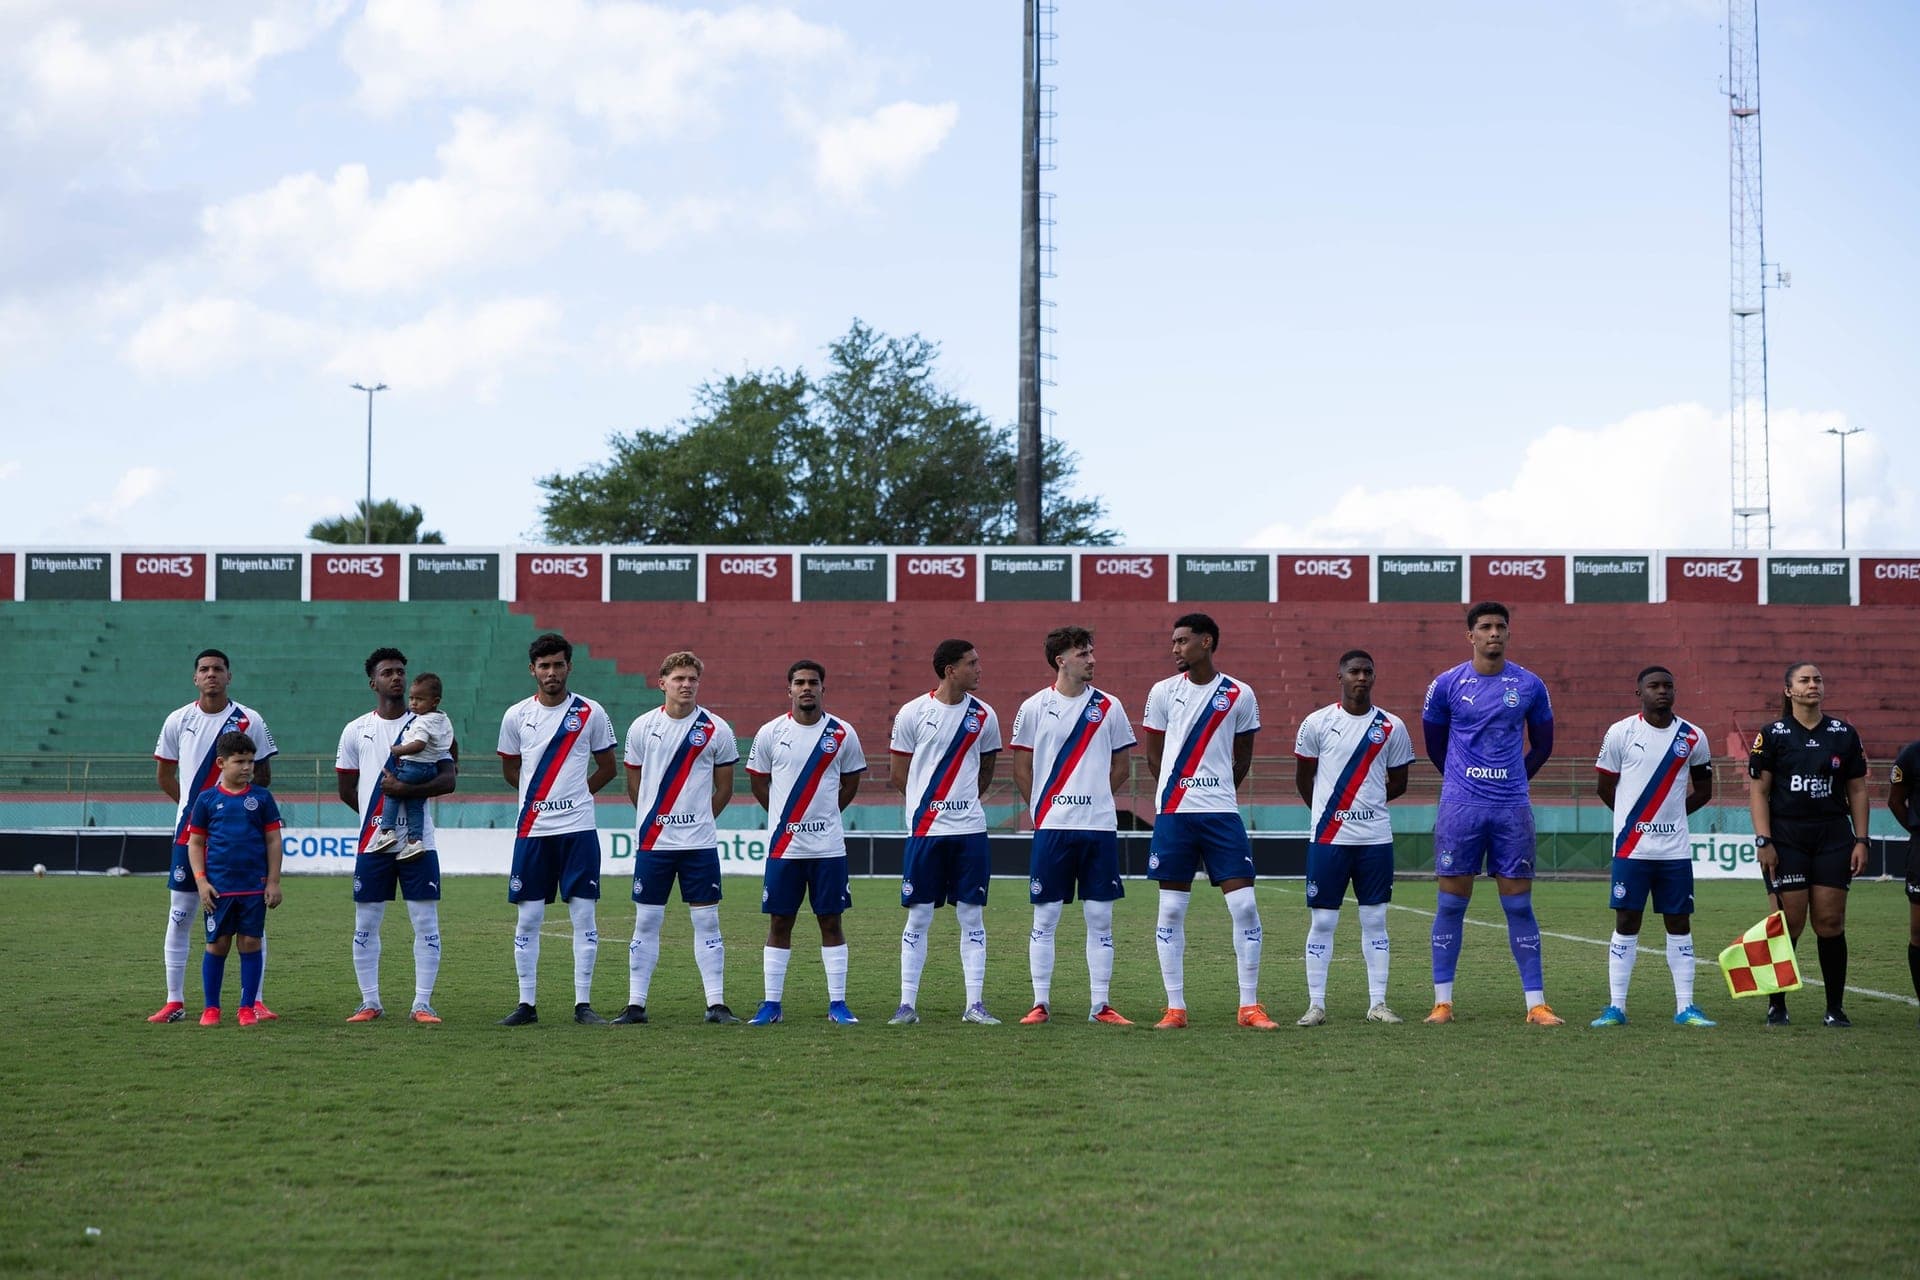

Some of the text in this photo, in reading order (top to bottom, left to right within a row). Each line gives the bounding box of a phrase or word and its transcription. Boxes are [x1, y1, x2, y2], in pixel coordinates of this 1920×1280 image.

[32, 558, 102, 572] Dirigente.NET
[136, 558, 192, 577] CORE3
[222, 558, 294, 572] Dirigente.NET
[327, 558, 383, 577] CORE3
[418, 559, 486, 573] Dirigente.NET
[531, 558, 588, 577] CORE3
[618, 559, 691, 574] Dirigente.NET
[721, 558, 777, 577] CORE3
[807, 559, 875, 573] Dirigente.NET
[908, 558, 965, 577] CORE3
[992, 560, 1064, 573] Dirigente.NET
[1096, 558, 1153, 578] CORE3
[1186, 560, 1256, 574] Dirigente.NET
[1295, 559, 1351, 579] CORE3
[1383, 561, 1456, 575] Dirigente.NET
[1489, 560, 1546, 579] CORE3
[1576, 562, 1644, 575] Dirigente.NET
[1684, 560, 1742, 582] CORE3
[1772, 563, 1844, 577] Dirigente.NET
[1875, 564, 1920, 579] CORE
[1466, 767, 1508, 779] FOXLUX
[1180, 777, 1220, 788] FOXLUX
[1790, 774, 1834, 795] Brasil
[533, 800, 574, 812] FOXLUX
[930, 801, 969, 812] FOXLUX
[1052, 795, 1092, 805] FOXLUX
[656, 814, 696, 826] FOXLUX
[1335, 810, 1375, 821] FOXLUX
[786, 822, 826, 834] FOXLUX
[1636, 822, 1676, 833] FOXLUX
